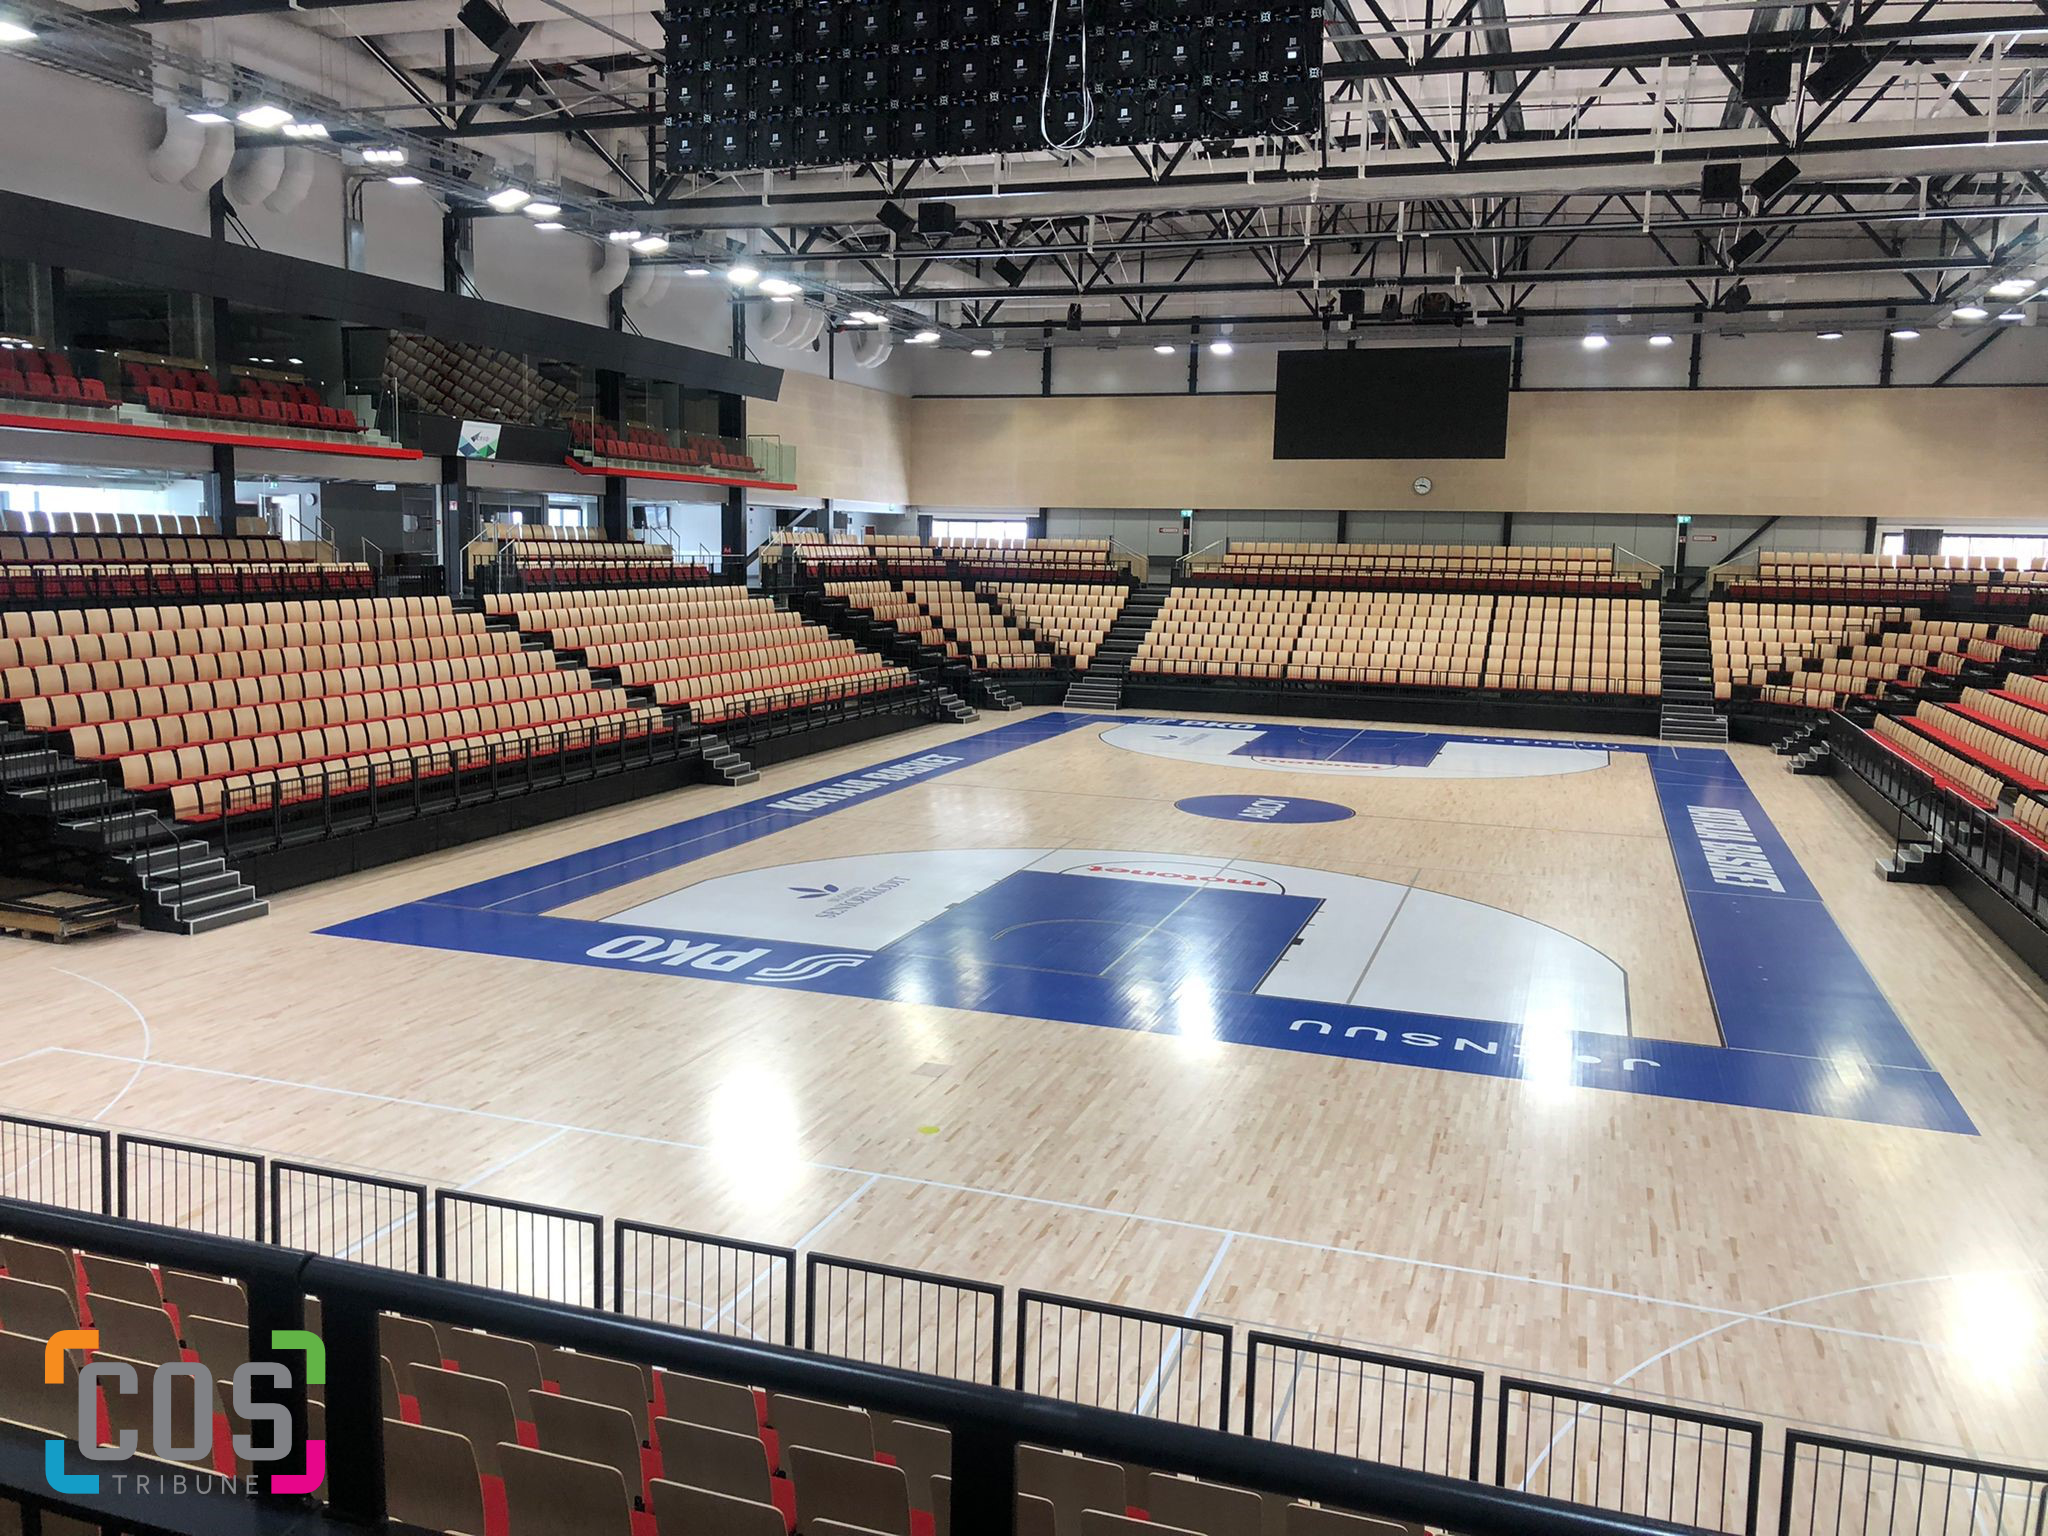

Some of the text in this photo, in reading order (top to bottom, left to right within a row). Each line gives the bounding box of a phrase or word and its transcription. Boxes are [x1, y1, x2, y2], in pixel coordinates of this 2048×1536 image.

[1179, 719, 1257, 729] PKO
[766, 753, 965, 811] KATAJA BASKET
[1238, 797, 1290, 820] ABLOY
[1686, 805, 1786, 893] KATAJA BASKET
[1088, 865, 1267, 887] motonet
[586, 935, 772, 972] PKO
